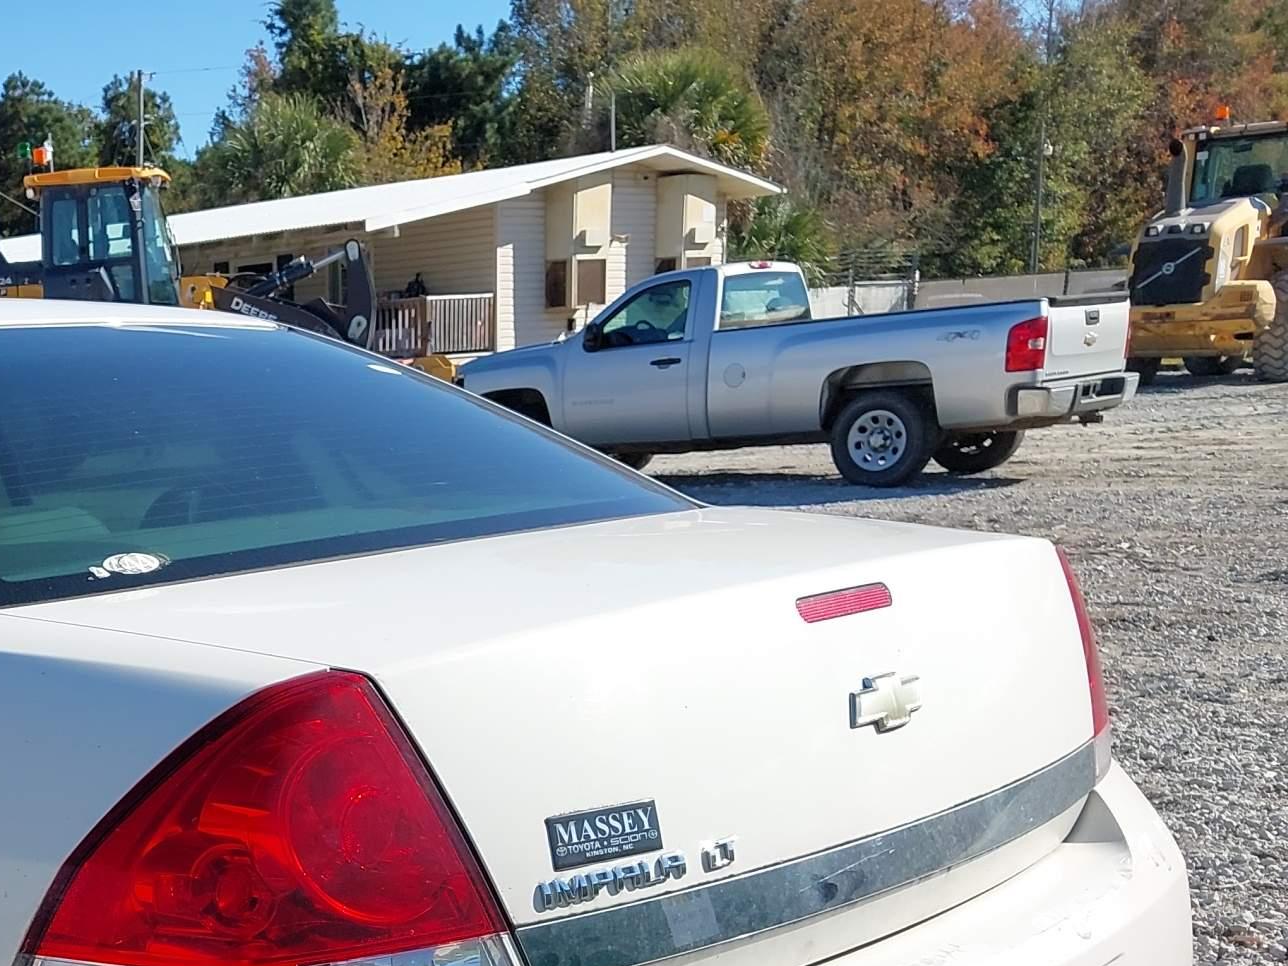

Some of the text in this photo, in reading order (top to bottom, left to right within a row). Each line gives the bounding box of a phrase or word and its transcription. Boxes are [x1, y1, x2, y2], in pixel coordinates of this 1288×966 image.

[554, 807, 652, 845] MASSEY
[567, 841, 601, 854] TOYOTA
[533, 835, 737, 912] IMPALA LT
